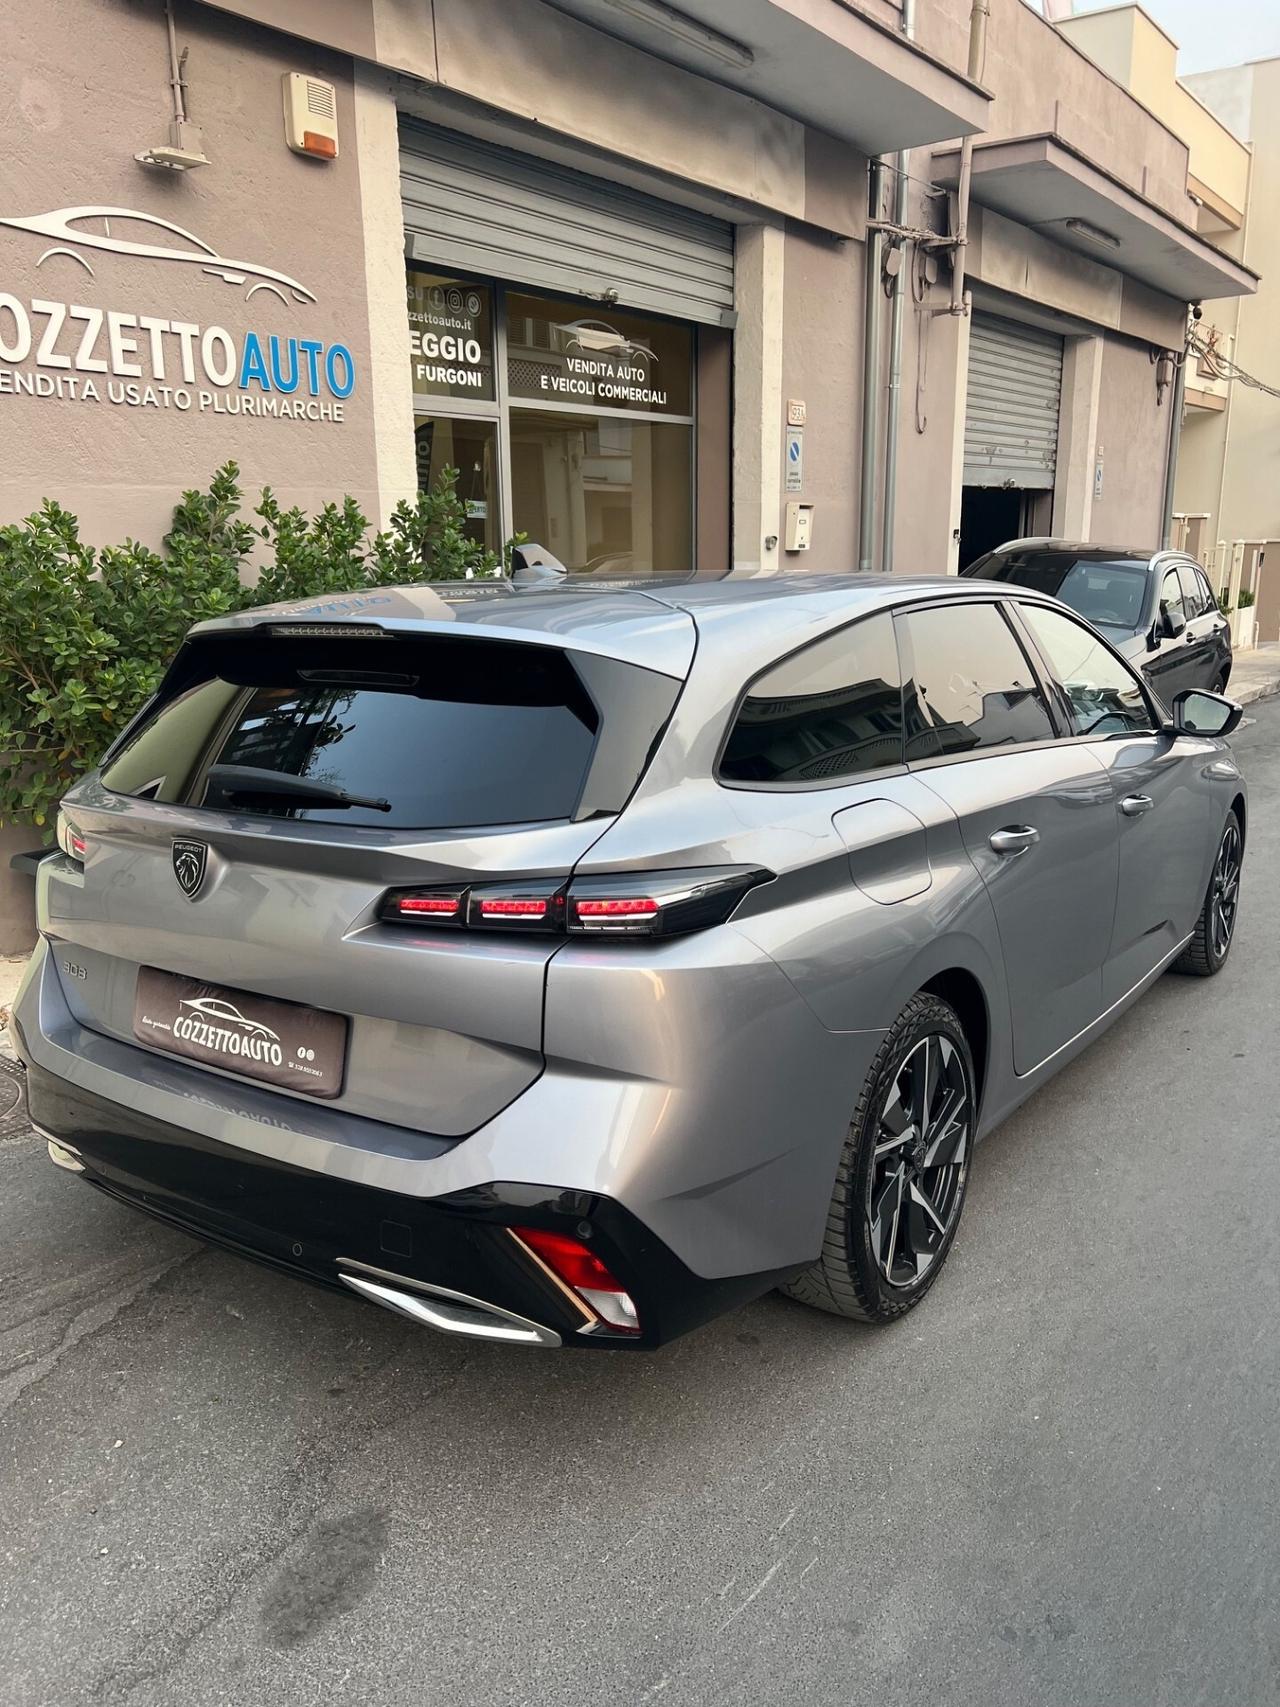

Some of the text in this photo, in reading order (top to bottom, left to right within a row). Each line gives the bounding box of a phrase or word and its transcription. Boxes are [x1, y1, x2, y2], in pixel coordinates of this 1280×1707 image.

[409, 330, 482, 364] EGGIO
[416, 364, 482, 387] FURGONI
[566, 357, 645, 382] VENDITA AUTO
[108, 382, 192, 411] USATO
[199, 391, 345, 423] PLURIMARCHE
[541, 375, 667, 404] E VEICOLI COMMERCIALI
[174, 844, 202, 853] PEUGEOT
[173, 1016, 282, 1066] COZZETTOAUTO
